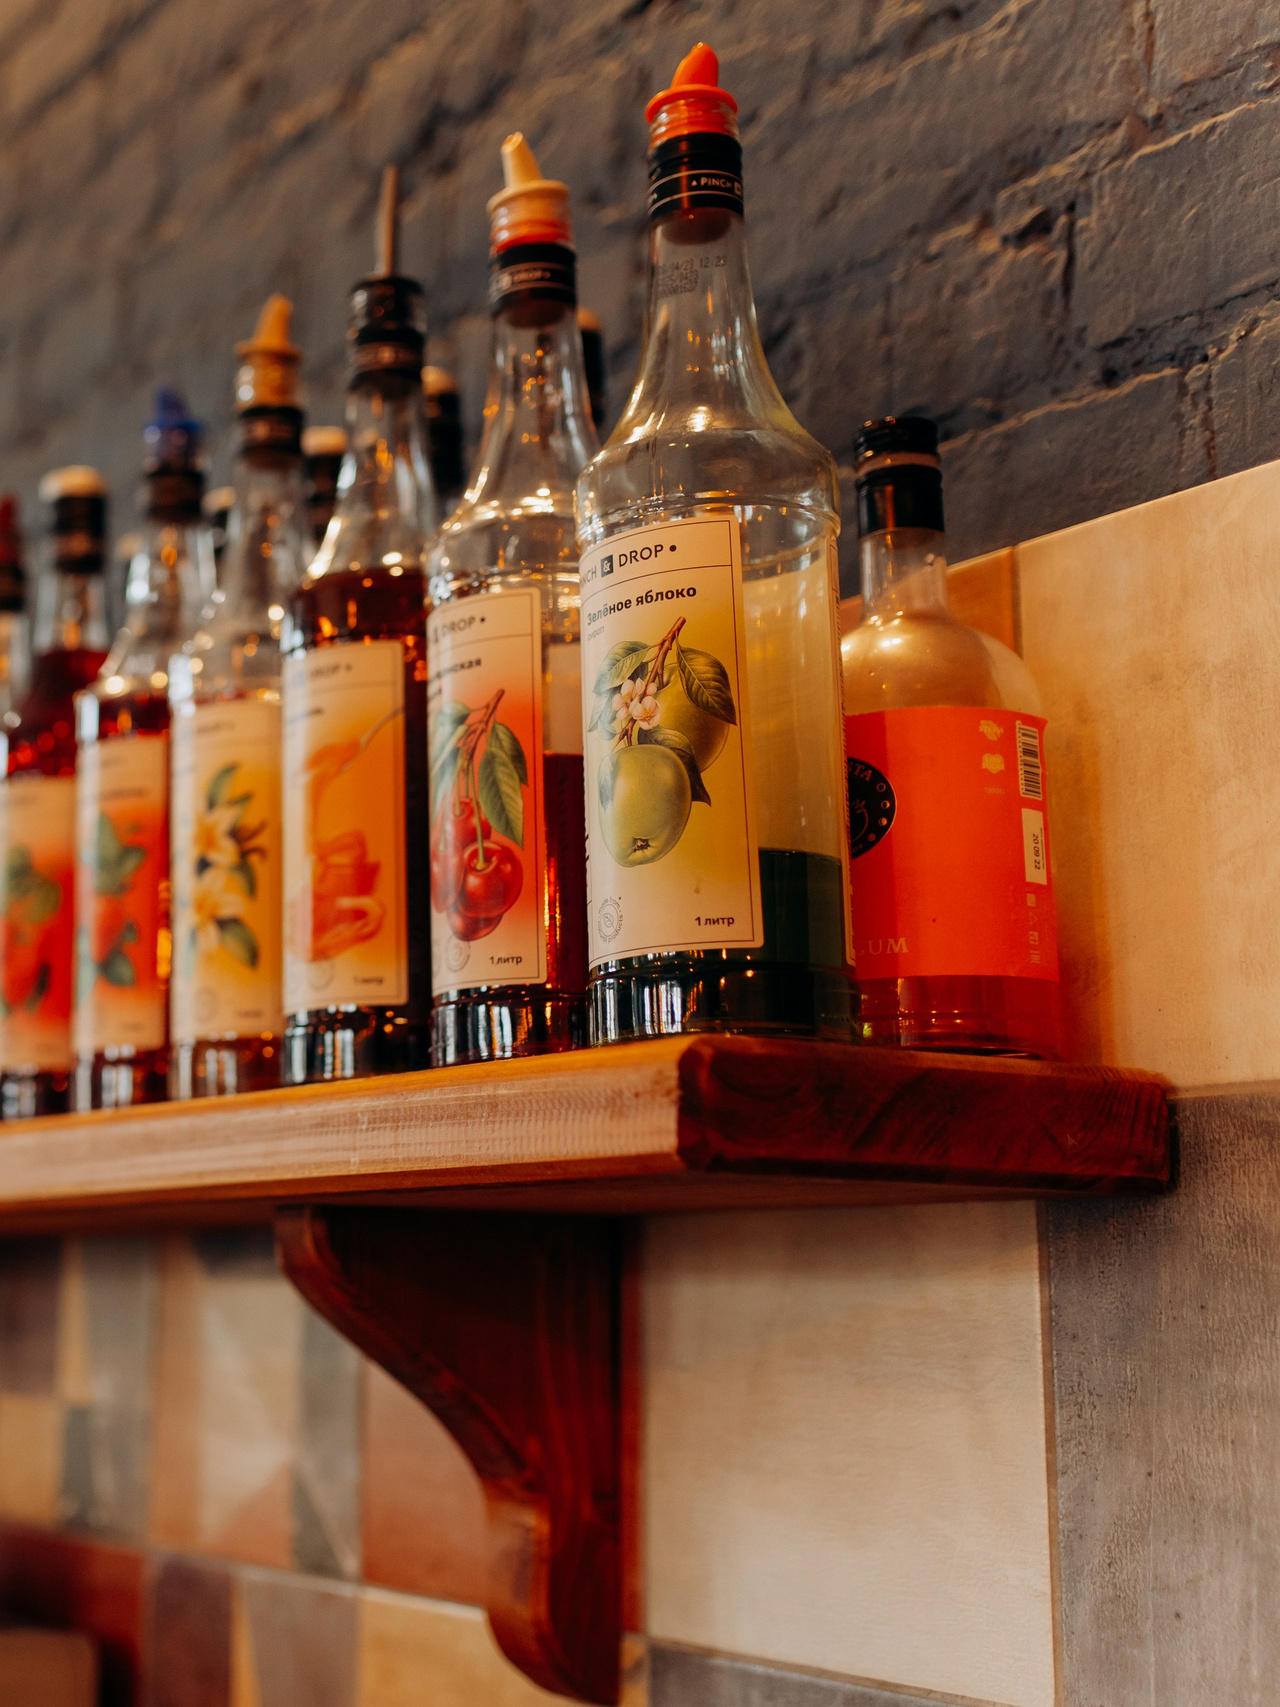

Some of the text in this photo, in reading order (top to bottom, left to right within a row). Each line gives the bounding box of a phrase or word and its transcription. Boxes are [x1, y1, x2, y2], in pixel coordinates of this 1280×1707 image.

[700, 177, 732, 188] PINCH
[618, 543, 664, 568] DROP
[587, 586, 697, 626] Зелёное яблоко
[695, 916, 735, 927] 1 литр
[496, 956, 523, 965] литр
